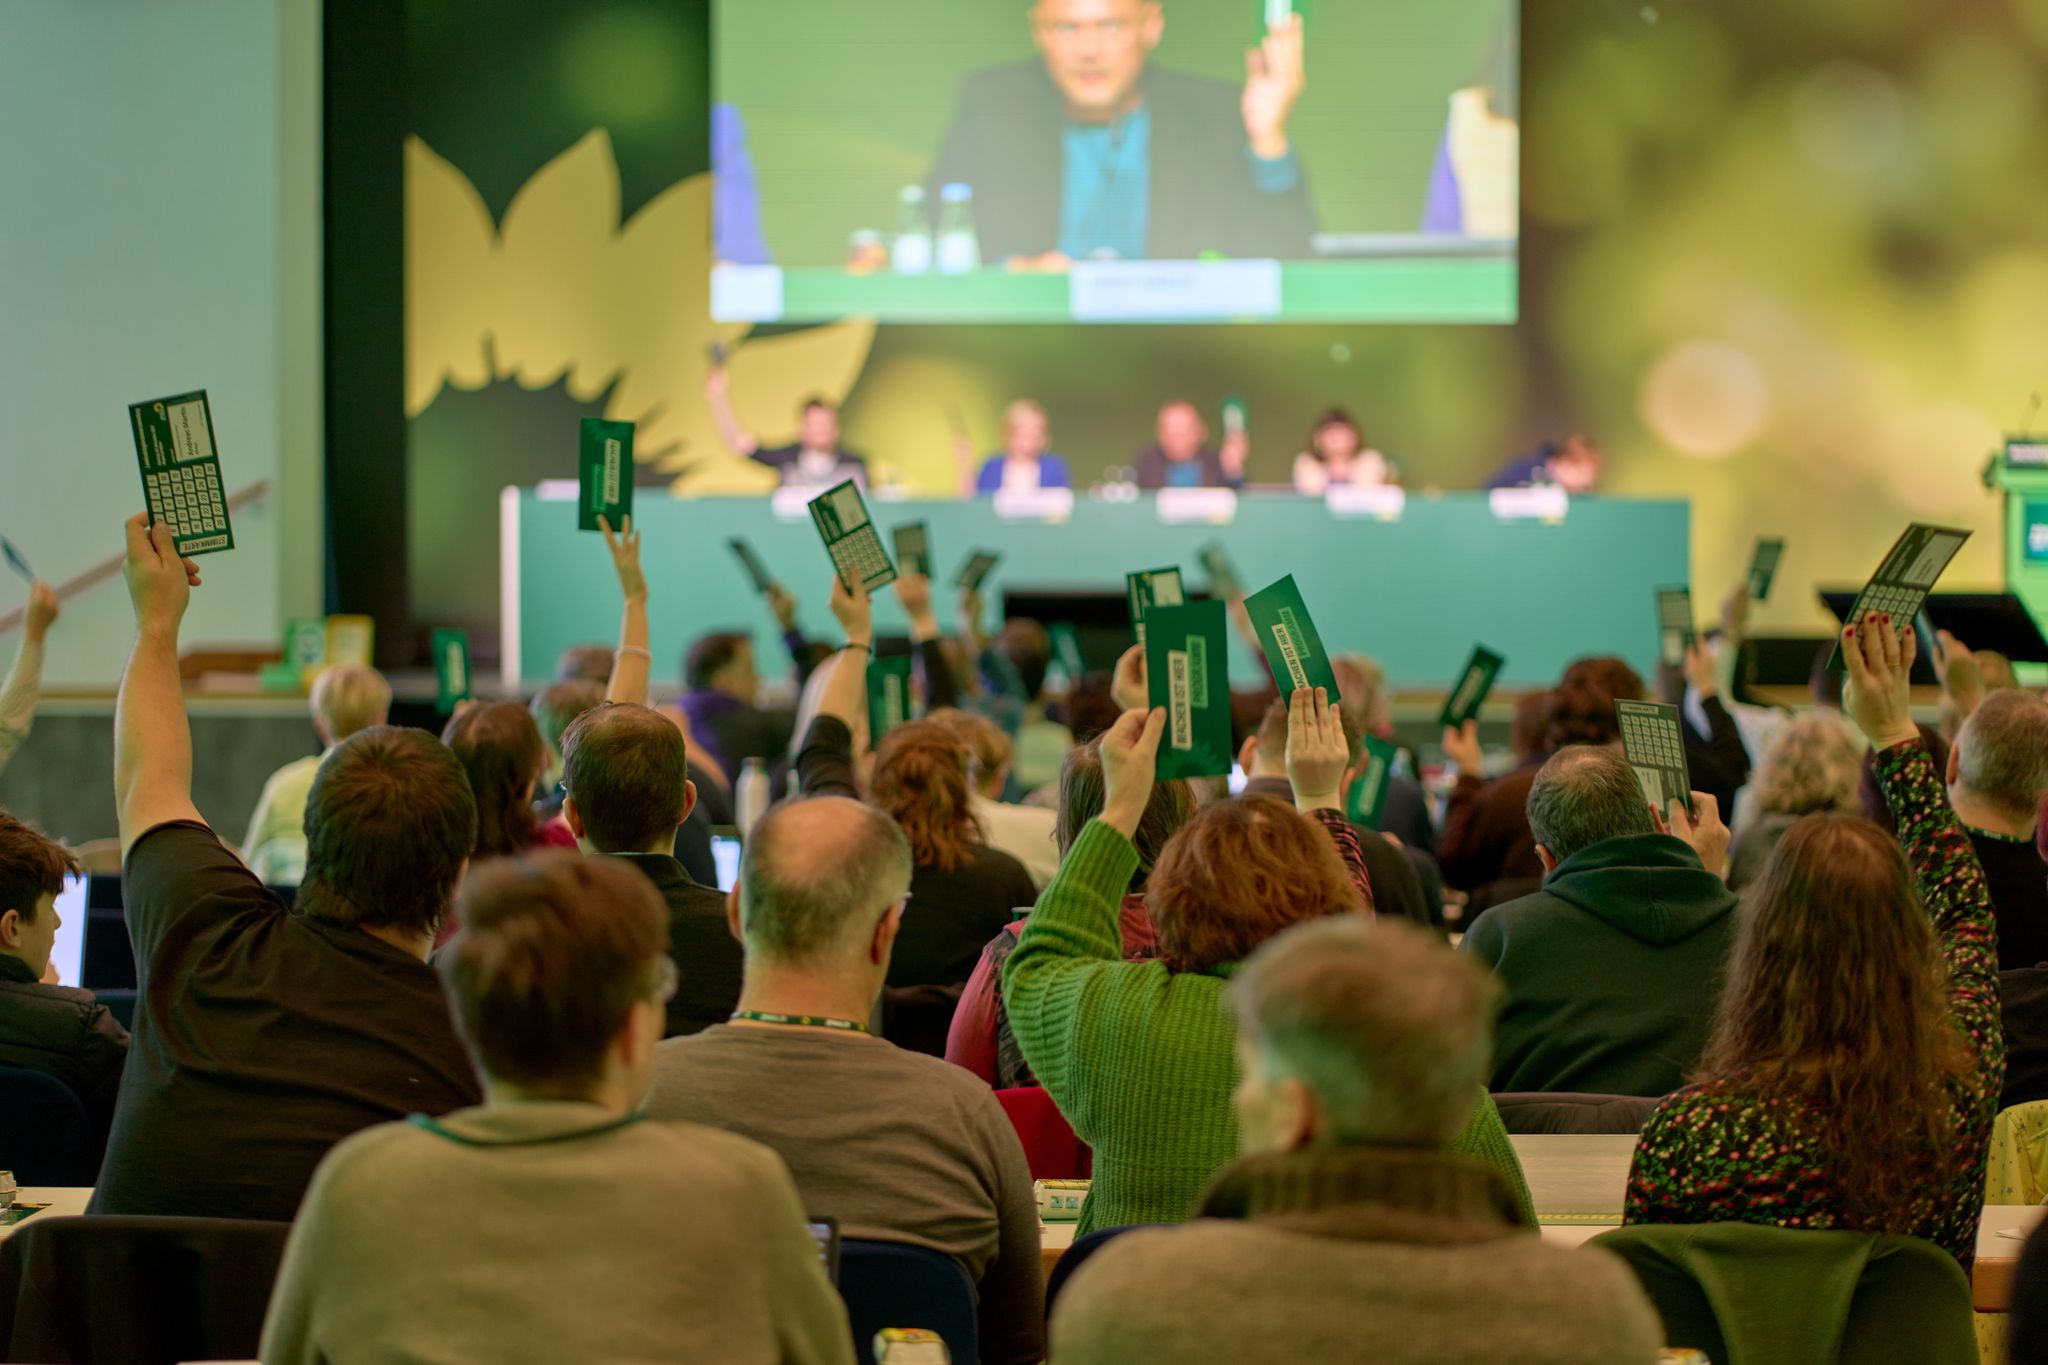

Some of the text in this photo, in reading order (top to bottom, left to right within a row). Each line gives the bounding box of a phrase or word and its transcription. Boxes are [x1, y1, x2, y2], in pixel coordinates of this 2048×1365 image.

[184, 536, 226, 550] STIMMKARTE
[1276, 628, 1288, 646] HIER
[1284, 646, 1293, 658] IST
